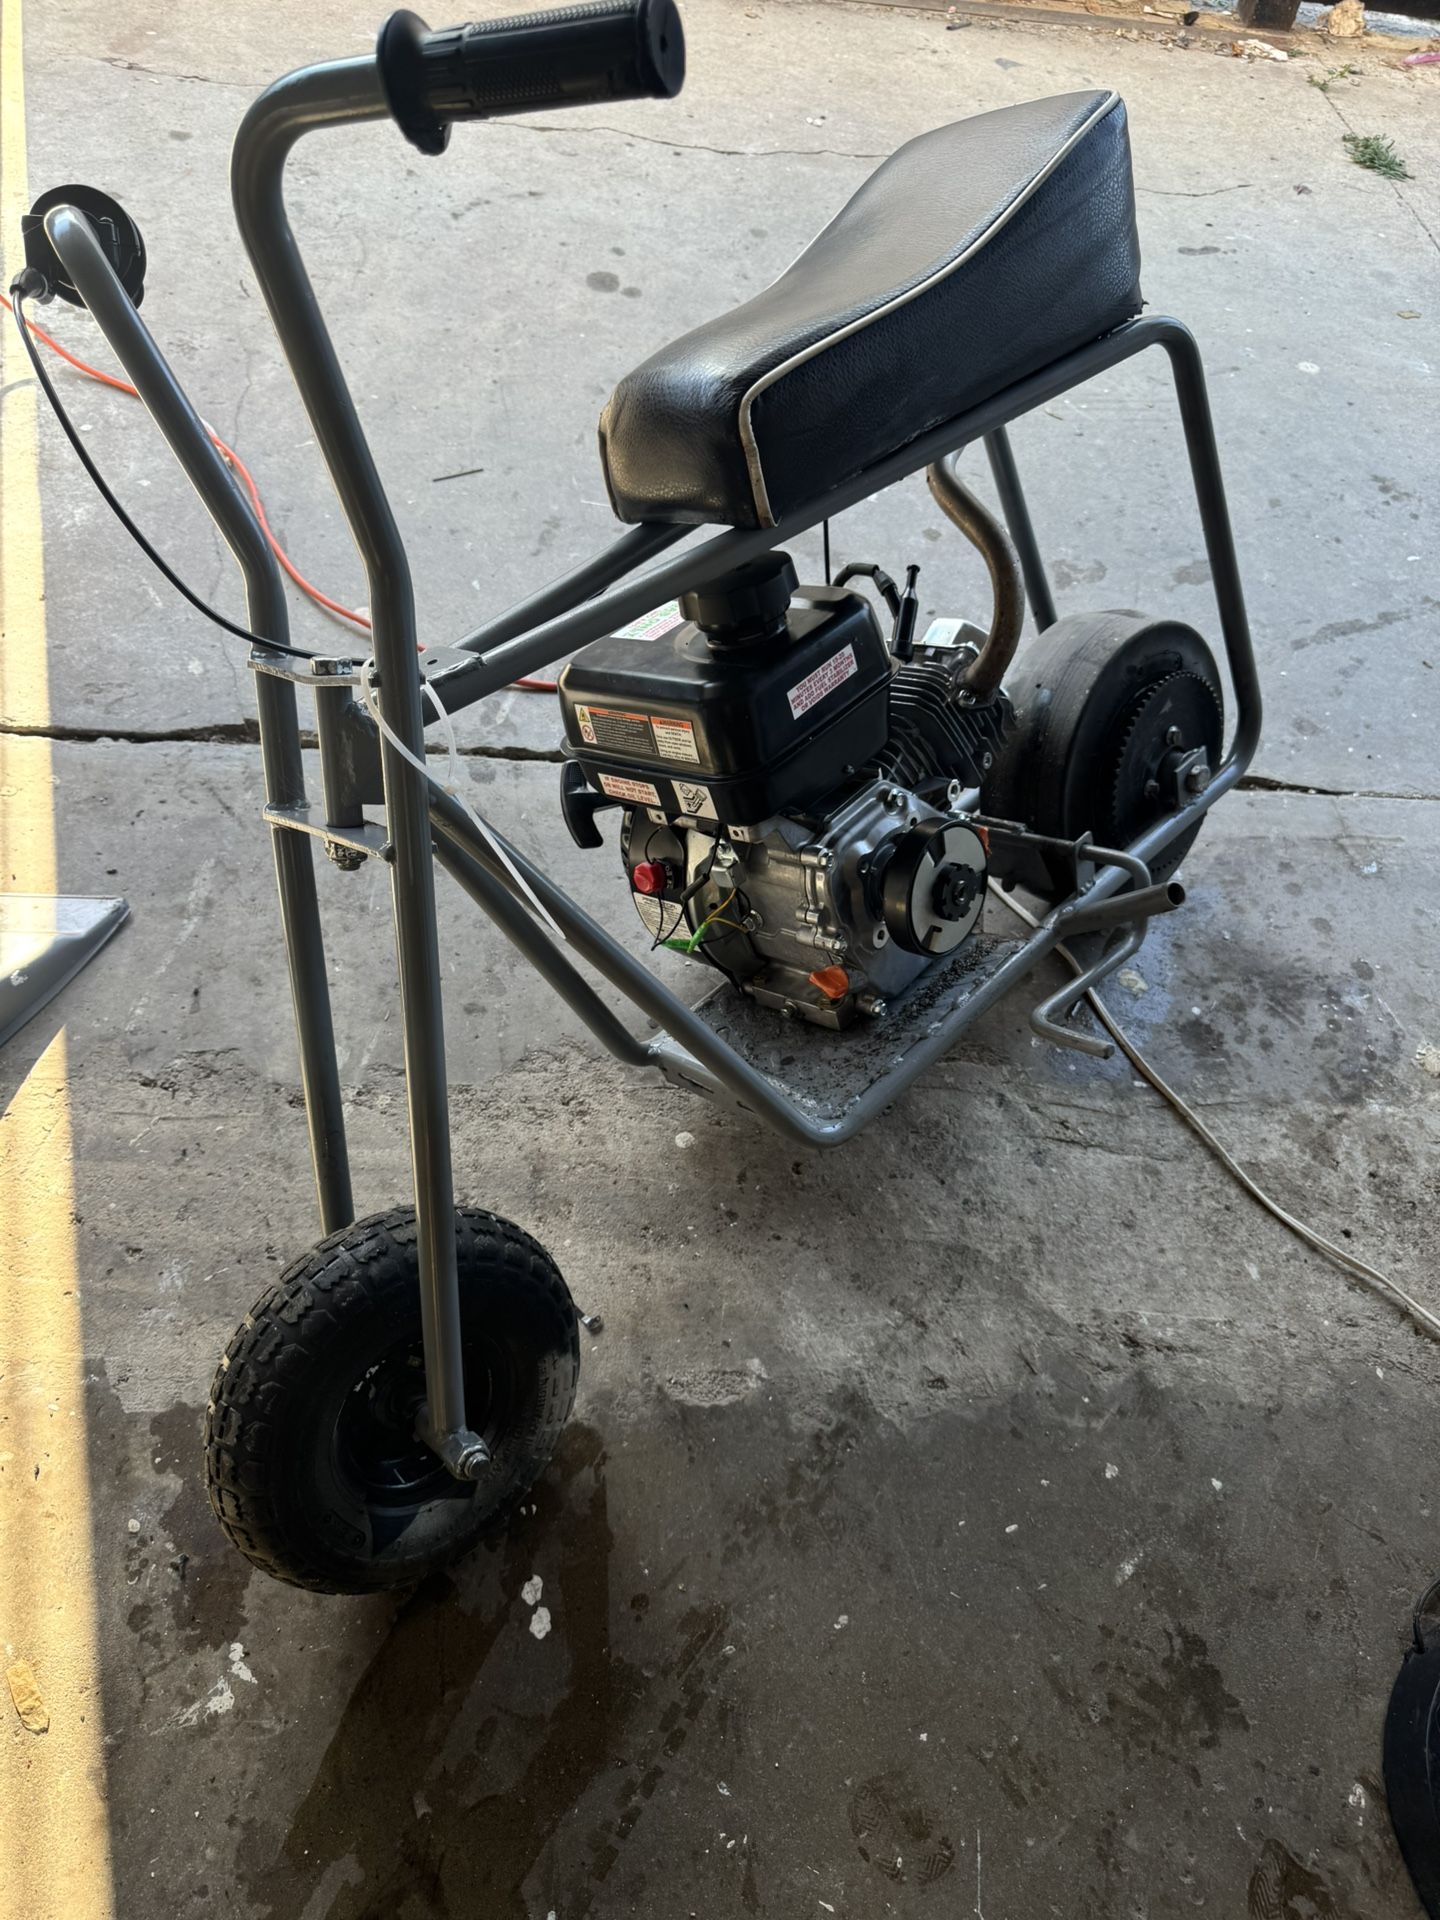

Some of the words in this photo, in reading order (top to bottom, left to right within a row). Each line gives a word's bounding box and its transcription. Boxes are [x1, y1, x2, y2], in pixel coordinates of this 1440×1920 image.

[791, 684, 813, 704] MINUTES
[813, 672, 829, 687] EVERY
[833, 653, 853, 670] MONTHS
[793, 698, 805, 710] AND
[804, 690, 815, 702] ADD
[815, 681, 827, 693] FUEL
[828, 659, 854, 682] STABILIZER
[796, 681, 807, 692] YOU
[807, 669, 820, 683] MUST
[821, 660, 833, 673] RUN
[801, 702, 809, 712] OR
[809, 691, 823, 704] VOIDS
[823, 670, 849, 692] WARRANTY
[608, 789, 626, 797] CHECK
[610, 777, 631, 786] ENGINE
[632, 781, 650, 790] STOPS
[611, 783, 625, 791] WILL
